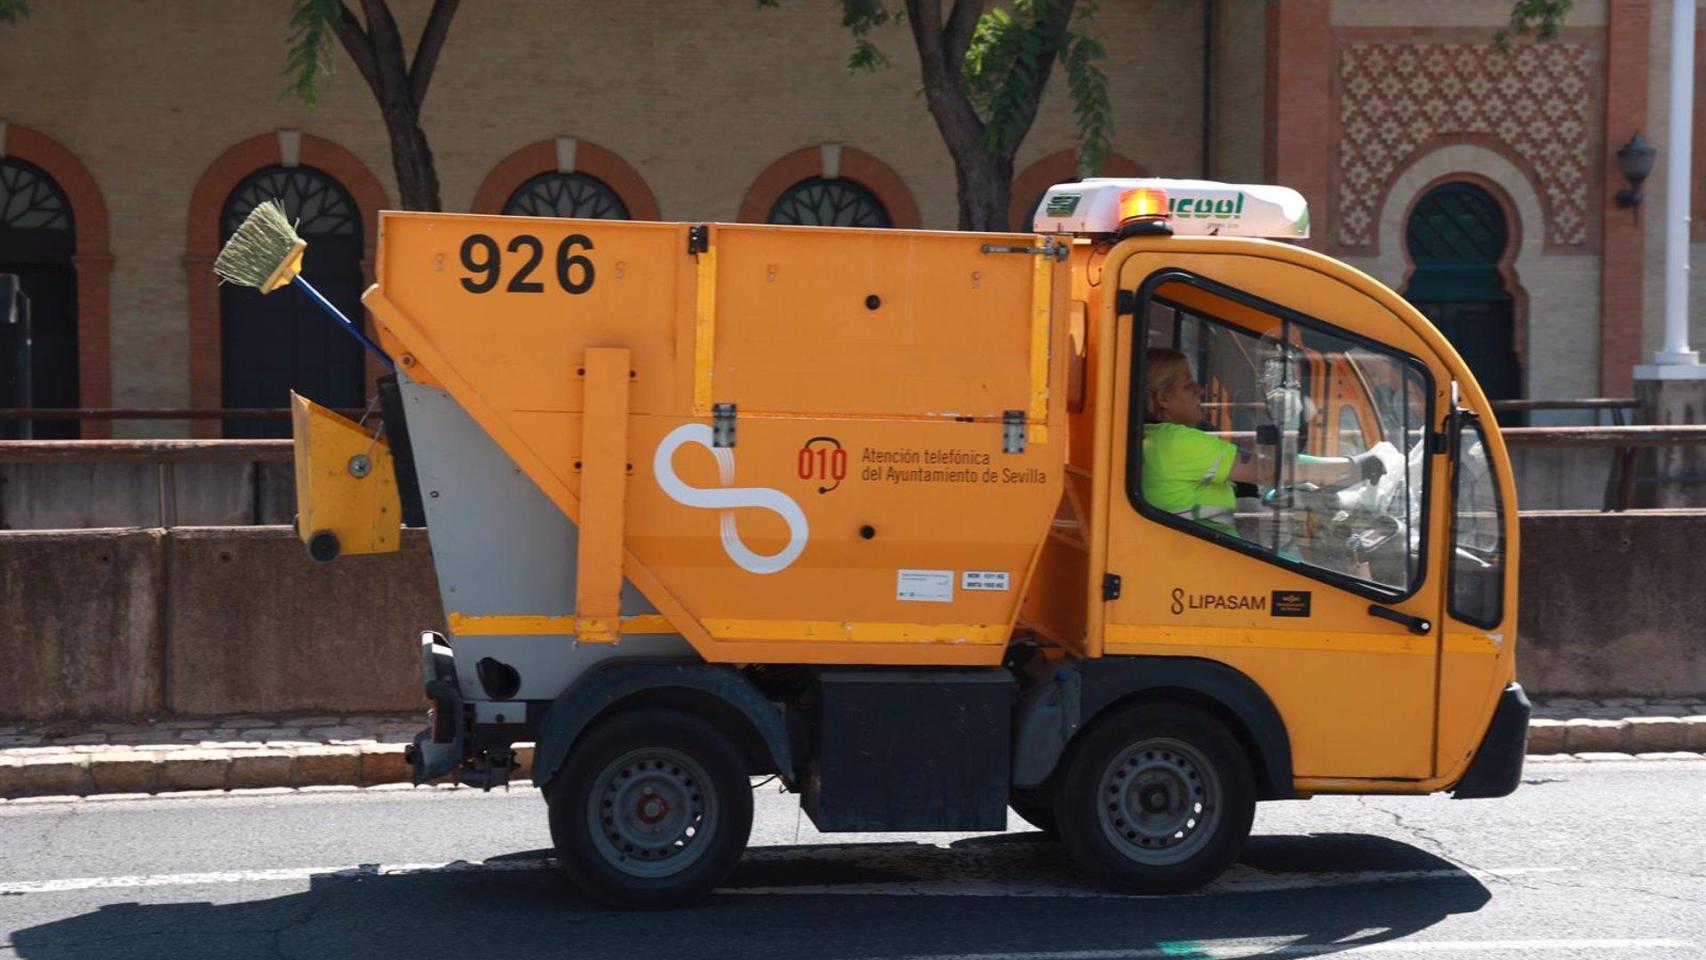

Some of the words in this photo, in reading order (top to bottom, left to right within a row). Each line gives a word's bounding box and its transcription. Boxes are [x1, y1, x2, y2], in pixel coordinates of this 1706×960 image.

[459, 233, 596, 295] 926
[798, 447, 847, 480] 010
[862, 447, 920, 464] Atención
[924, 448, 991, 465] telefónica
[862, 466, 882, 482] del
[886, 466, 978, 484] Ayuntamiento
[982, 468, 999, 483] de
[1002, 467, 1047, 484] Sevilla
[1188, 594, 1267, 611] LIPASAM
